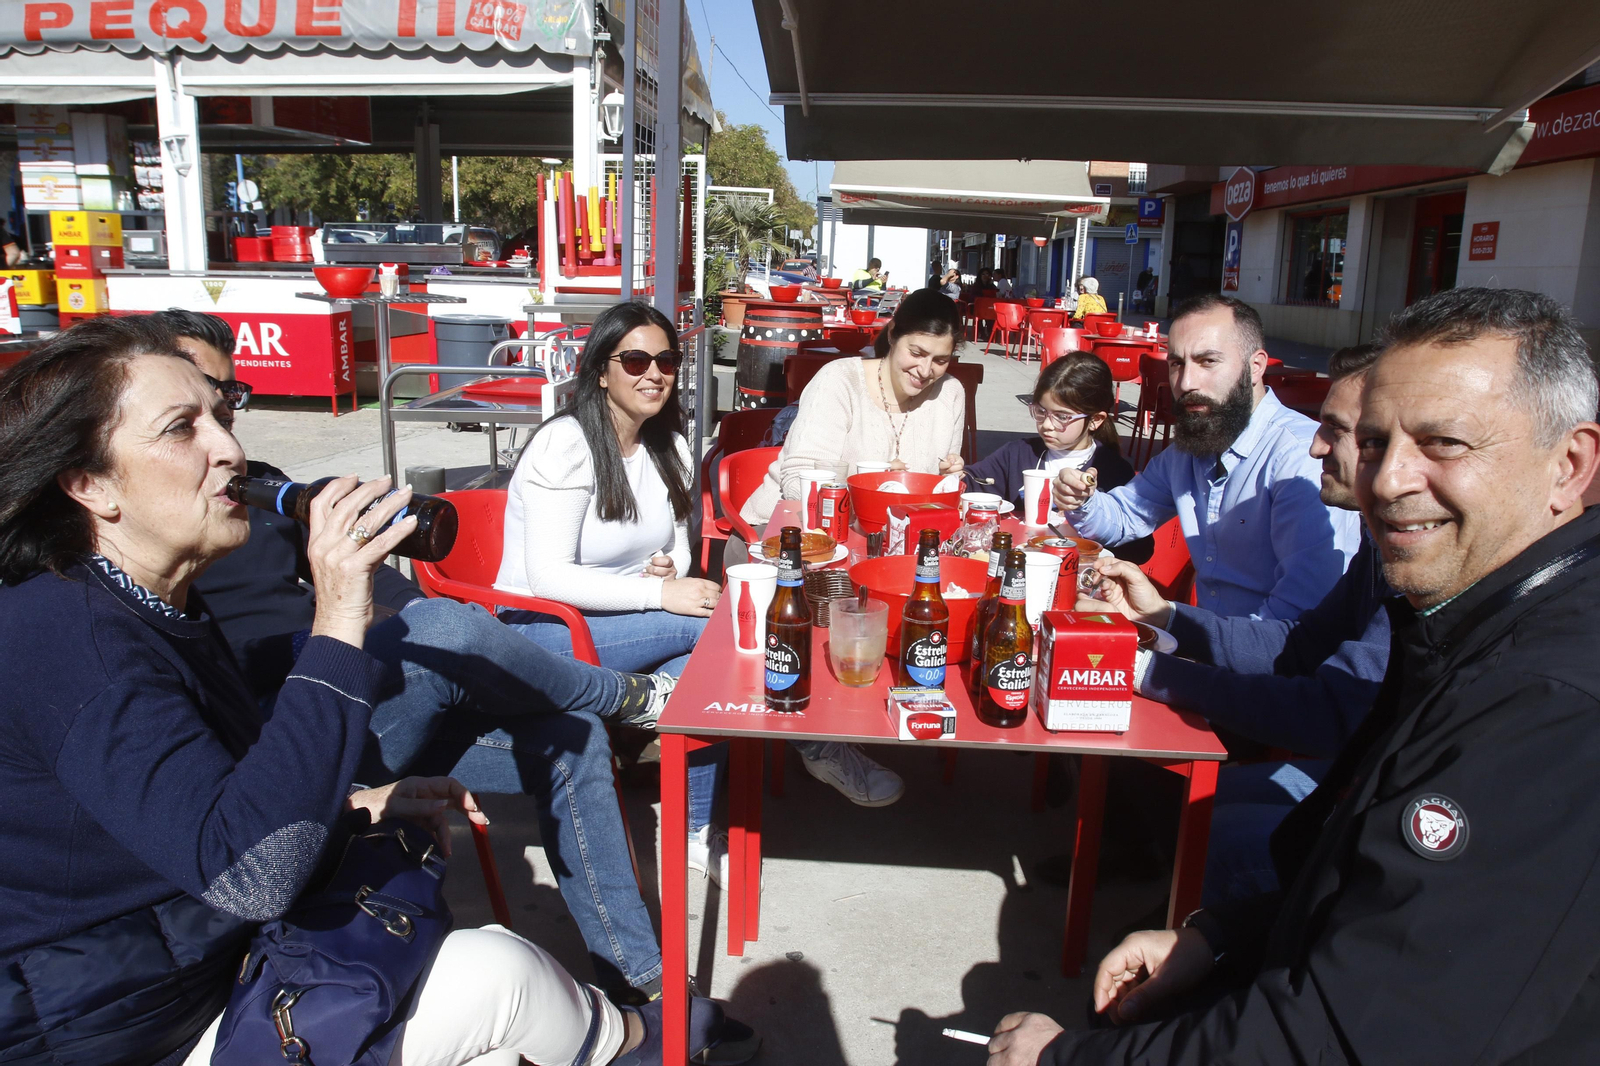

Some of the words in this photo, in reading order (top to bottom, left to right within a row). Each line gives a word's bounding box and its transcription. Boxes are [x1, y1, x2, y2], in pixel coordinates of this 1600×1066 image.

[474, 2, 521, 24] 100%
[24, 0, 342, 44] PEQUE
[397, 0, 456, 37] II
[470, 16, 518, 40] CALIDAD
[1530, 110, 1600, 140] w.dezac
[1264, 179, 1289, 194] tenemos
[1289, 175, 1297, 189] lo
[1297, 177, 1310, 189] que
[1310, 172, 1319, 185] tú
[1320, 166, 1347, 186] quieres
[1144, 201, 1156, 215] P
[59, 230, 82, 238] AMBAR
[1473, 234, 1495, 243] HORARIO
[233, 322, 290, 357] AR
[338, 318, 351, 382] AMBAR
[235, 359, 292, 368] PENDIENTES
[765, 647, 792, 663] trella
[914, 644, 947, 657] Estrell
[765, 659, 790, 673] alicia
[925, 668, 940, 681] 0,0
[1058, 669, 1128, 686] AMBAR
[703, 701, 806, 716] AMB
[911, 722, 941, 730] Fortuna
[1414, 797, 1464, 828] JAGUAR
